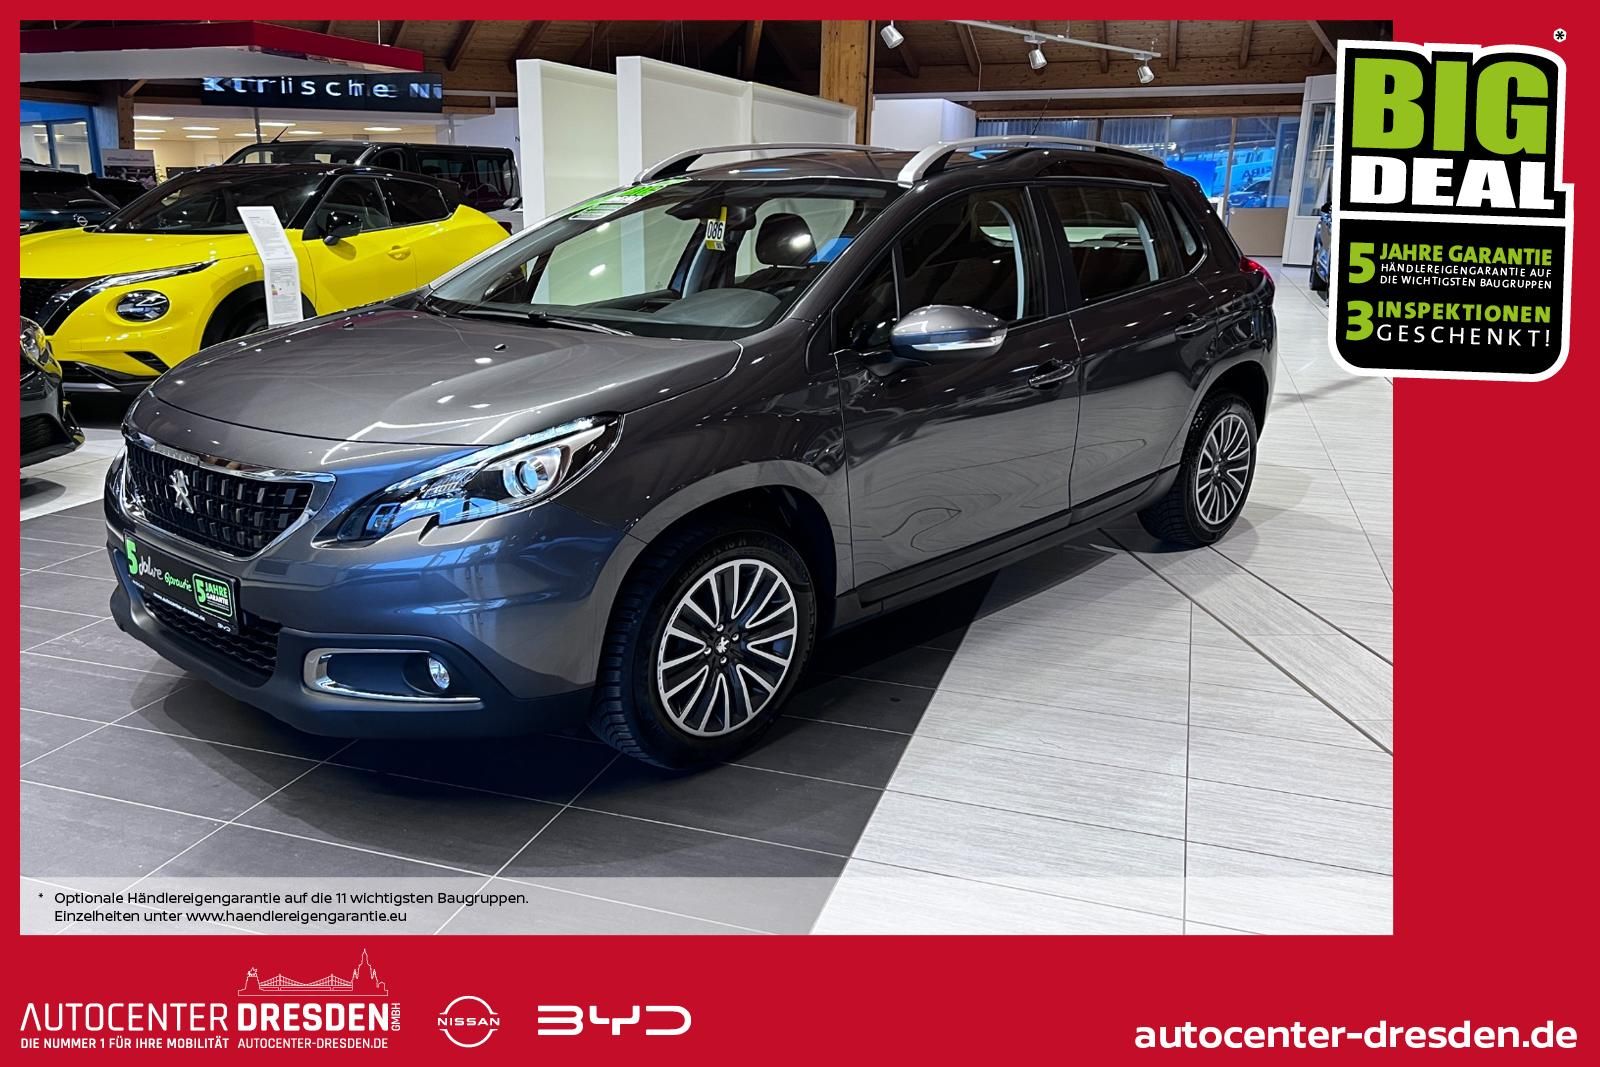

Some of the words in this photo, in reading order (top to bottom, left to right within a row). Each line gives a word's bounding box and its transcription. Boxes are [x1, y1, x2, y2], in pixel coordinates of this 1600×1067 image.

[707, 221, 724, 240] 086
[126, 536, 139, 575] 5
[195, 579, 206, 603] 5
[205, 581, 228, 598] JAHRE
